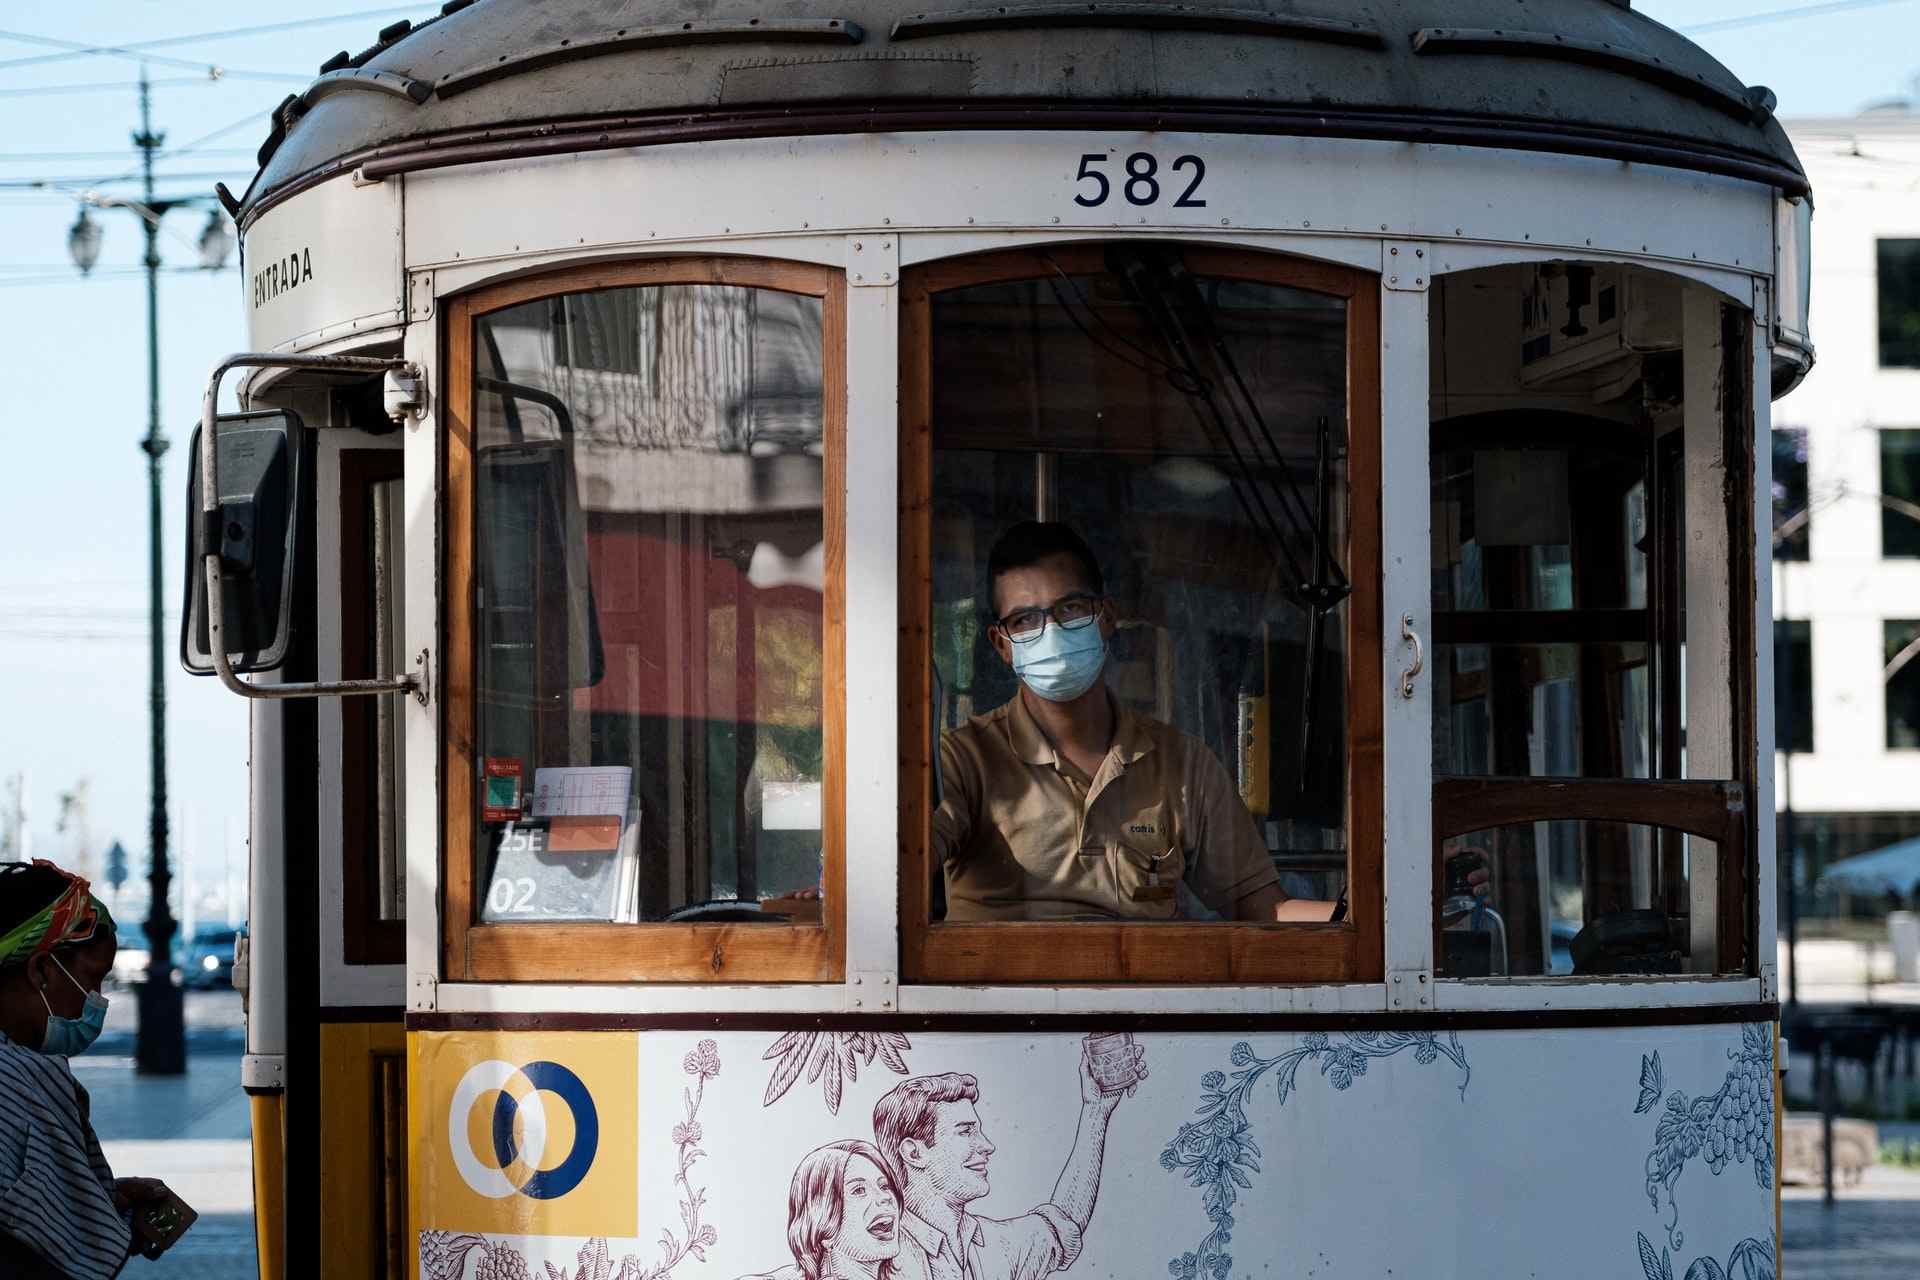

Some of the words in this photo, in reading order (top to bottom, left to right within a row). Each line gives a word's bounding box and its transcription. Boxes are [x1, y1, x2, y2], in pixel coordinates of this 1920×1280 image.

[1073, 152, 1206, 207] 582
[255, 247, 312, 309] ENTRADA
[497, 828, 543, 851] 25E
[489, 877, 537, 913] 02
